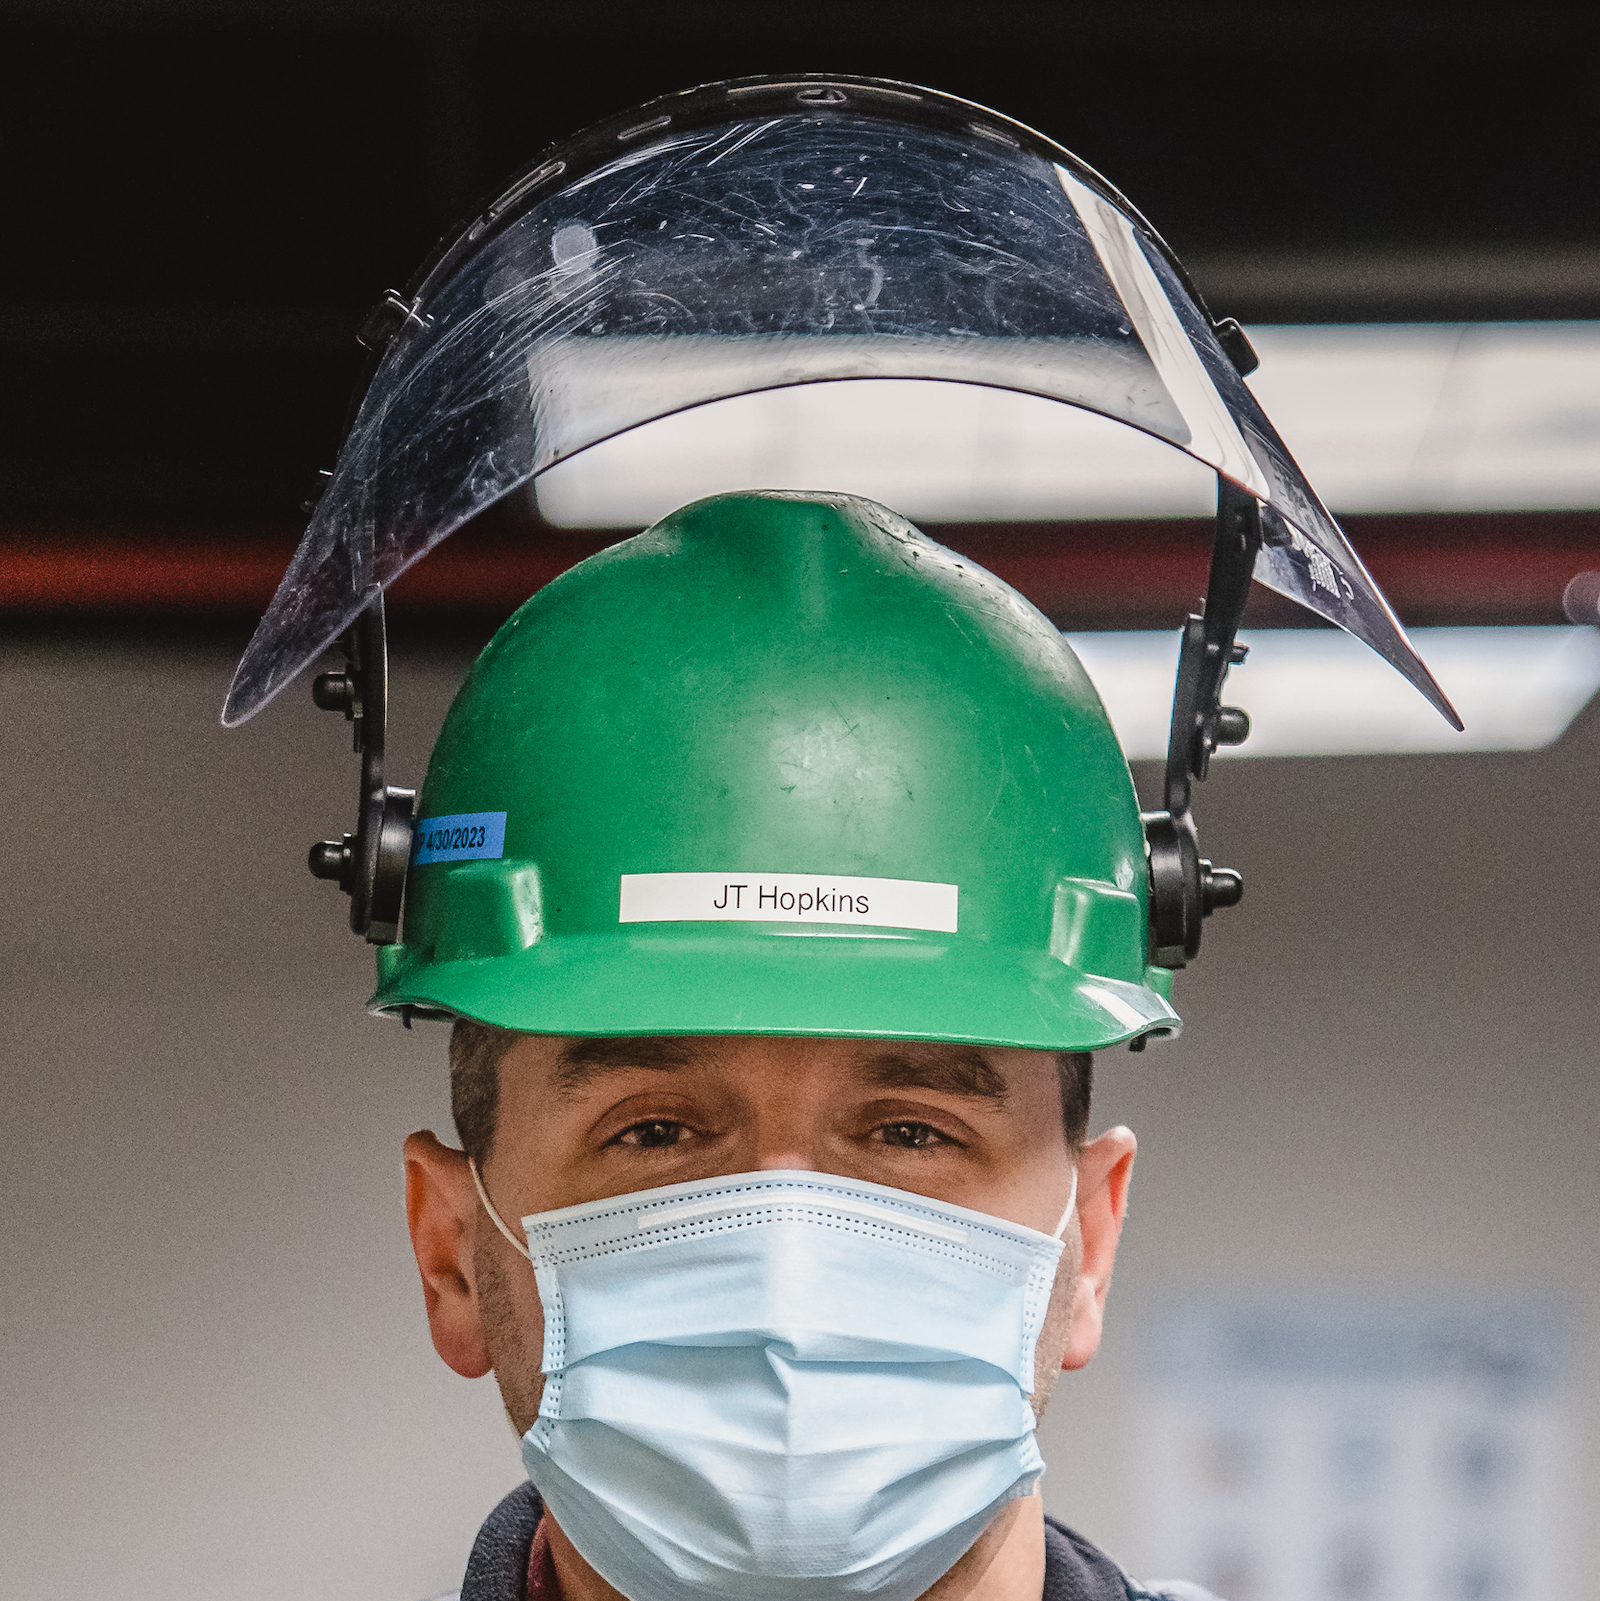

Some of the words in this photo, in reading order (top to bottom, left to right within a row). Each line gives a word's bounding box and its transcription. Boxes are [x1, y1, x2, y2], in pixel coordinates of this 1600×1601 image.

[426, 826, 486, 852] 4/30/2023
[714, 884, 748, 910] JT
[759, 886, 870, 916] Hopkins
